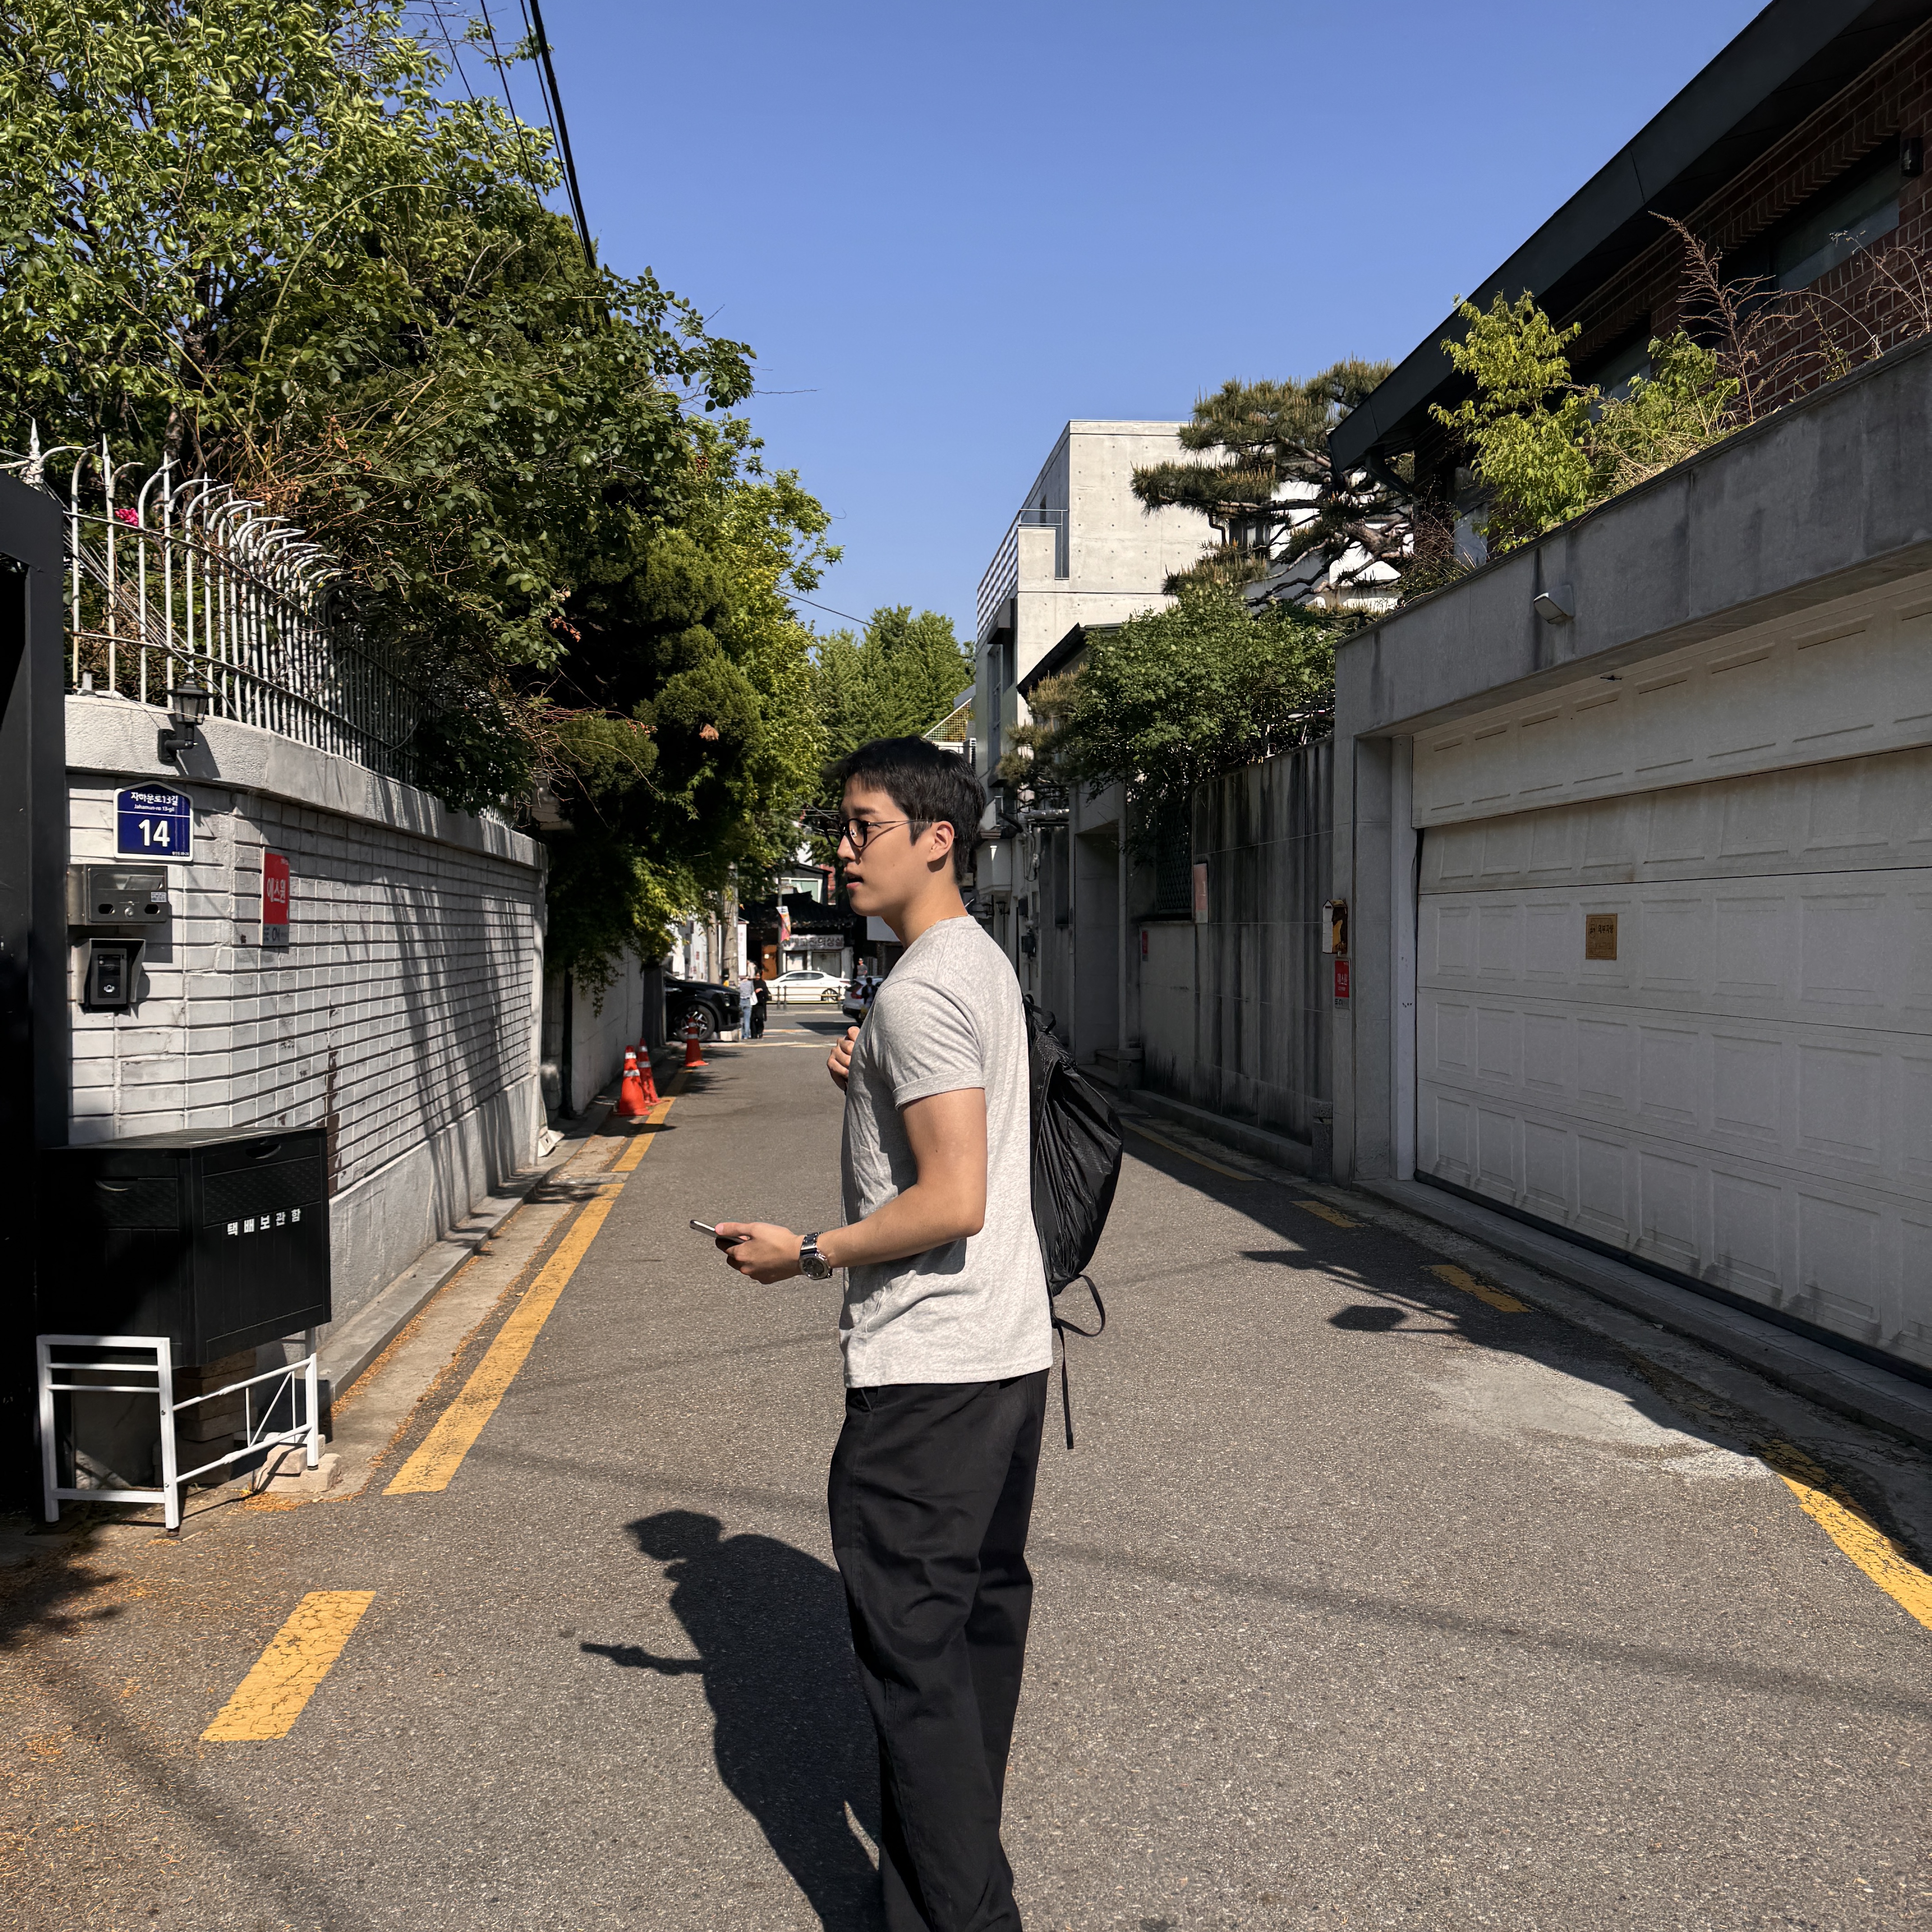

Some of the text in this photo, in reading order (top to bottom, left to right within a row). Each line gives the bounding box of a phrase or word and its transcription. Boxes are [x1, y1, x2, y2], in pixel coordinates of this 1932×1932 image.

[131, 792, 178, 806] 자하문로13길
[138, 819, 170, 847] 14
[267, 877, 286, 904] 에스원
[227, 1208, 301, 1236] 택배보관함
